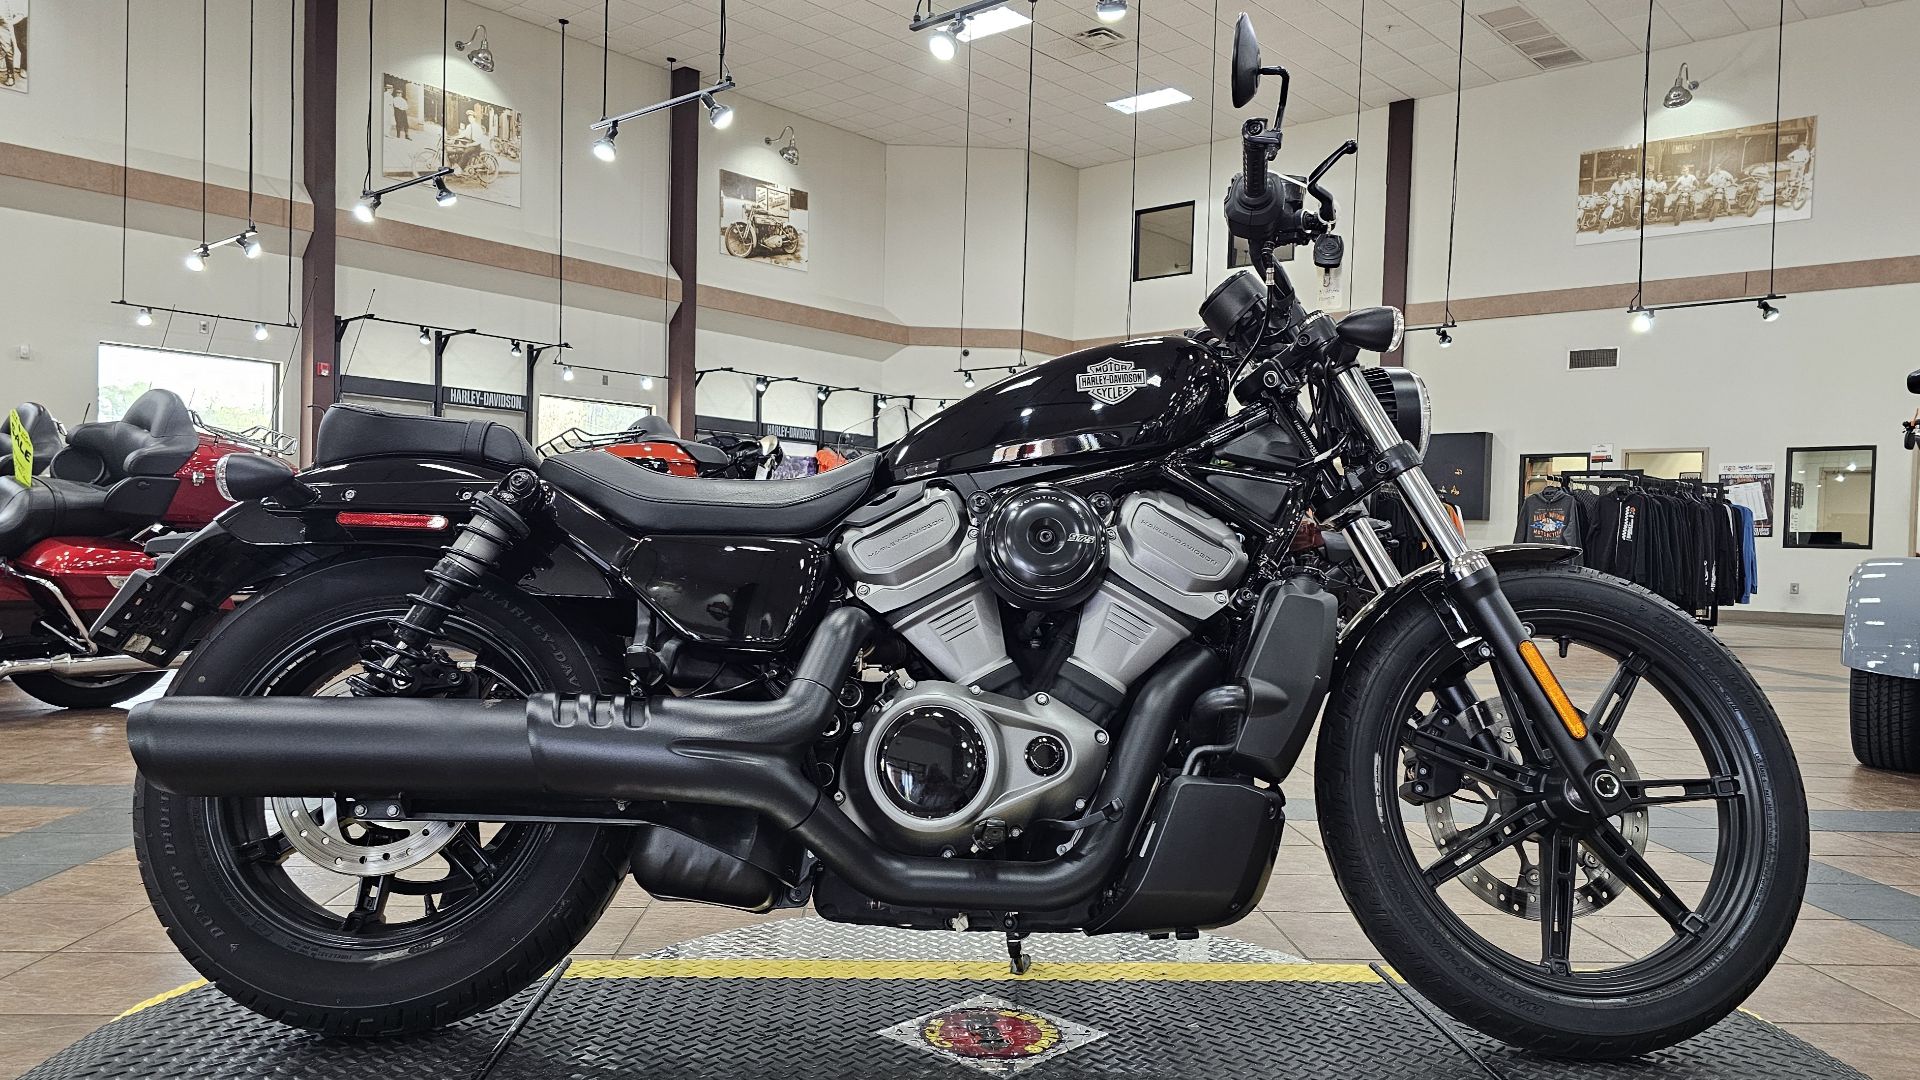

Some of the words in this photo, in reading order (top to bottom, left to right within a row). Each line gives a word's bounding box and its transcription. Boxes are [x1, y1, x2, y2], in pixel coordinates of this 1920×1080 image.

[1094, 362, 1129, 373] MOTOR
[1081, 372, 1143, 387] HARLEY-DAVIDSON
[450, 388, 522, 410] HARLEY-DAVIDSON
[1096, 386, 1129, 399] CYCLES
[767, 424, 816, 441] HARLEY-DAVIDSON
[1139, 519, 1219, 567] HARLEY-DAVIDSON
[483, 590, 583, 689] HARLEY-DAV
[169, 865, 226, 939] DUNLOP
